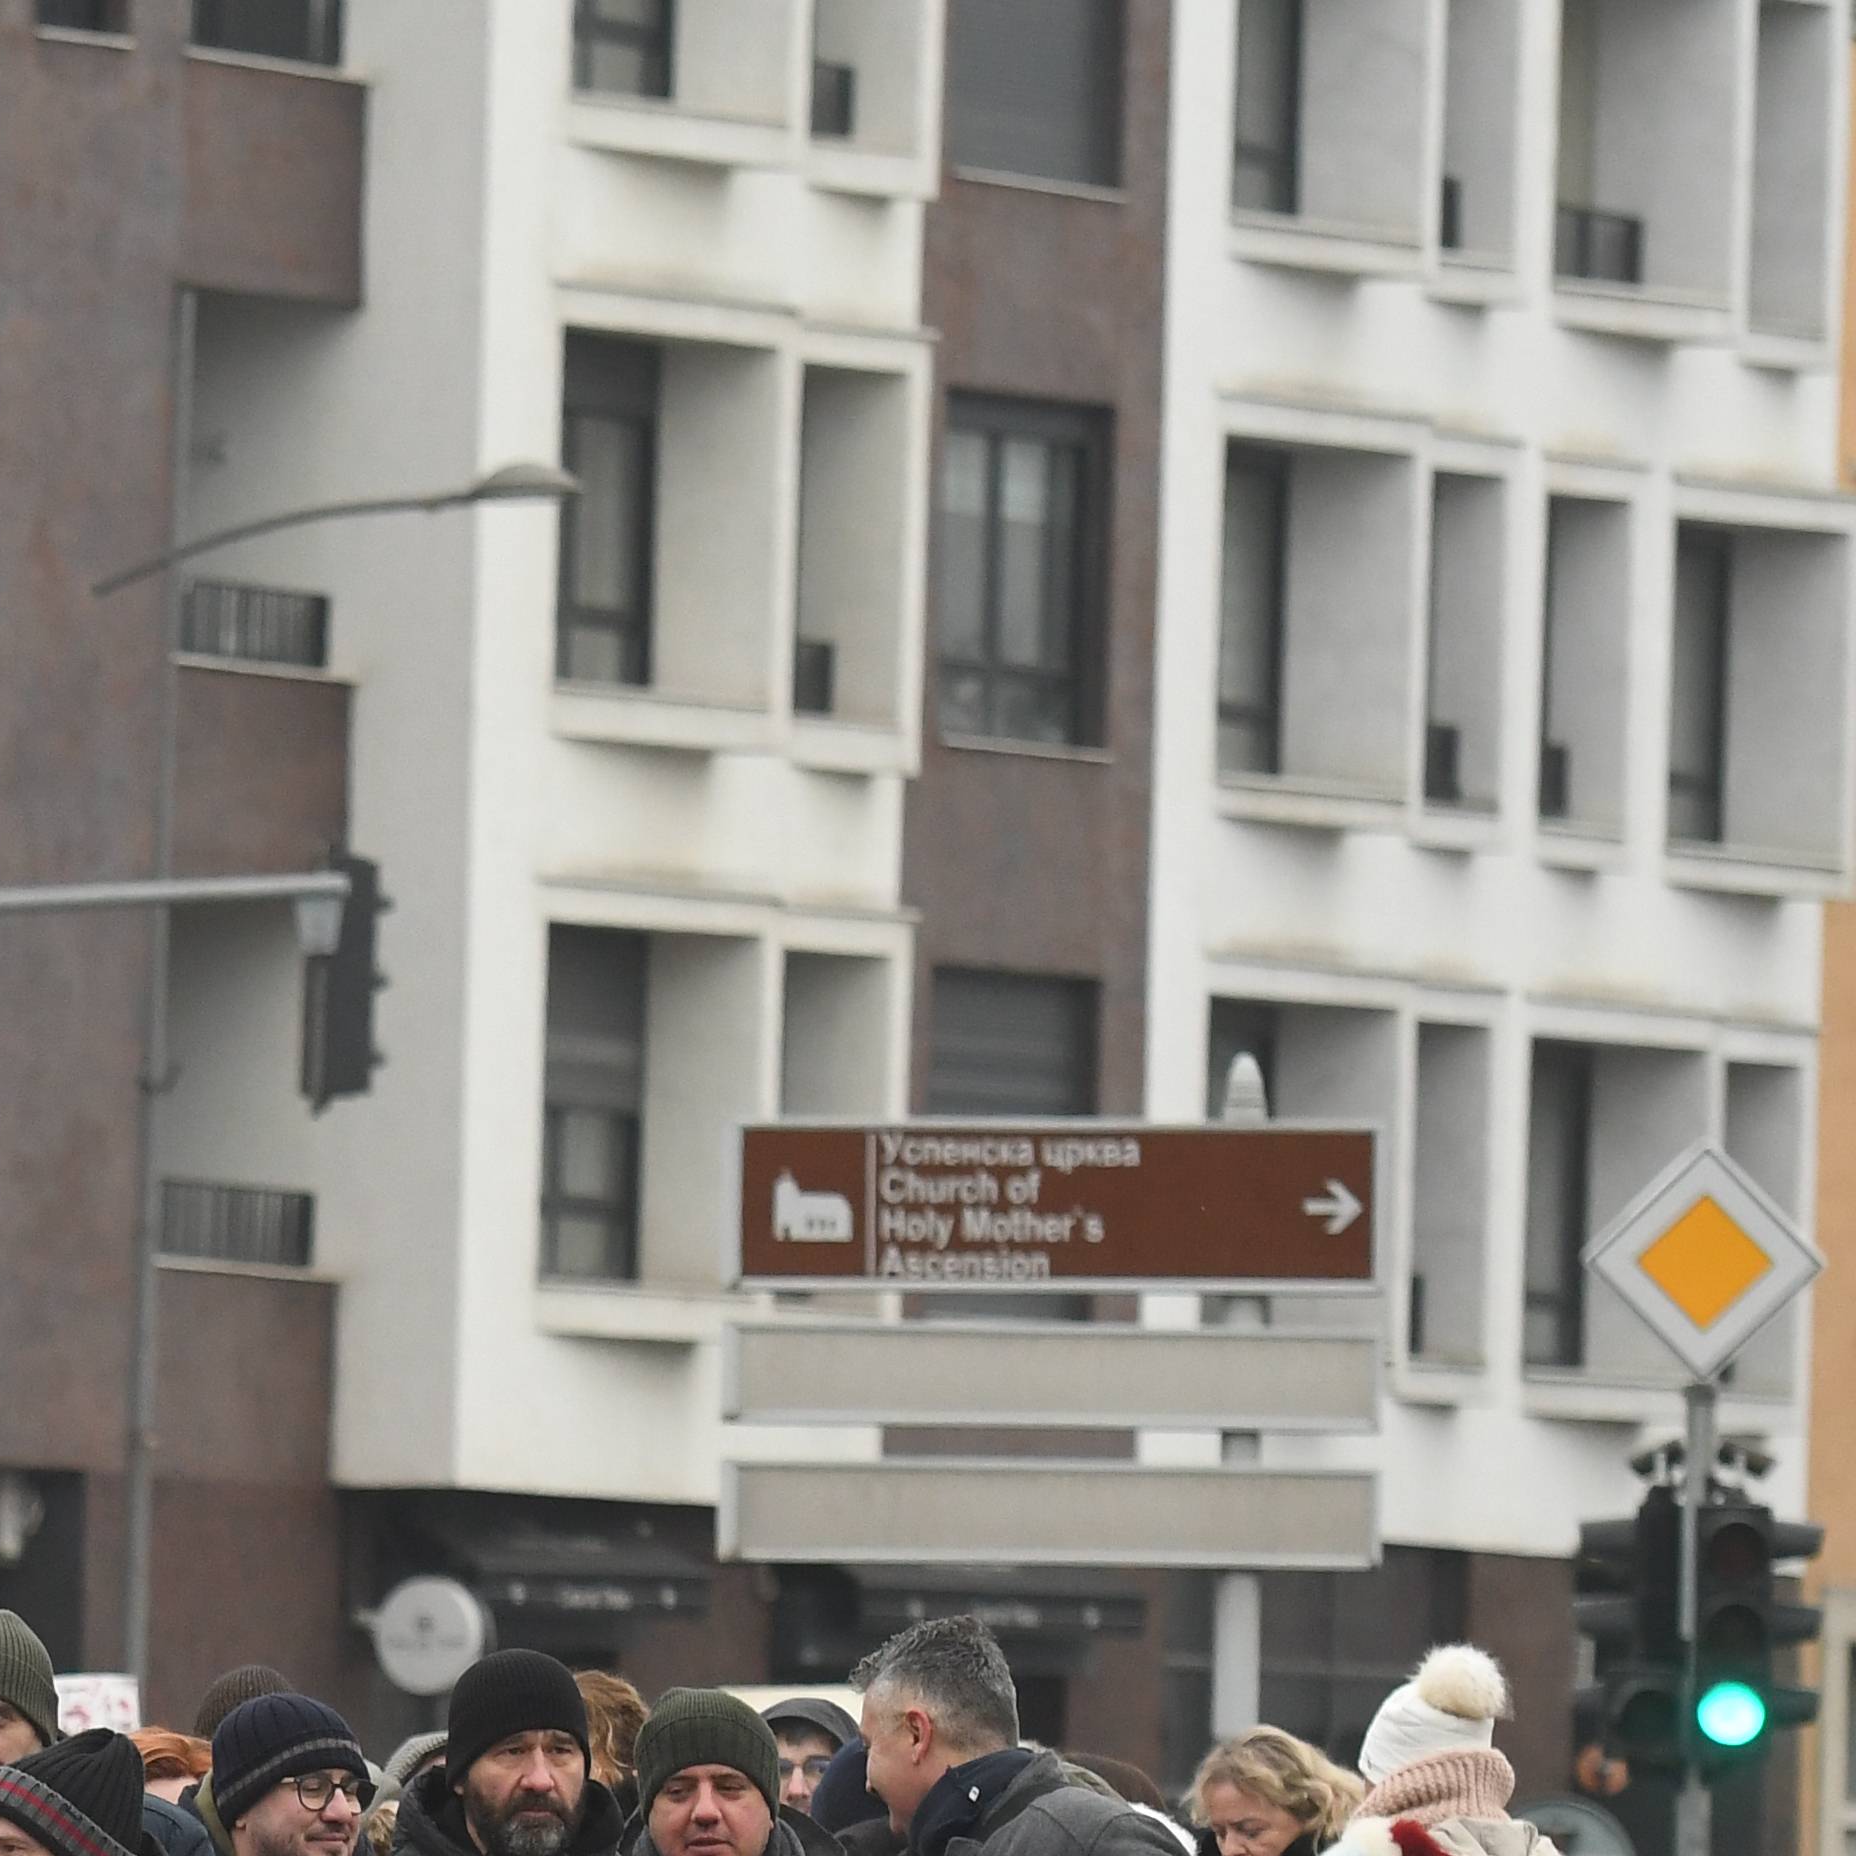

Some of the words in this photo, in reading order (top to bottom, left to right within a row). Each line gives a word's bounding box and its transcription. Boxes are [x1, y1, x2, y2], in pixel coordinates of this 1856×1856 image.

[879, 1133, 1035, 1168] Успенска
[1040, 1137, 1141, 1175] црква
[879, 1166, 999, 1204] Church
[1005, 1167, 1042, 1204] of
[879, 1206, 956, 1251] Holy
[962, 1205, 1105, 1243] Mother's
[879, 1244, 1051, 1277] Ascension
